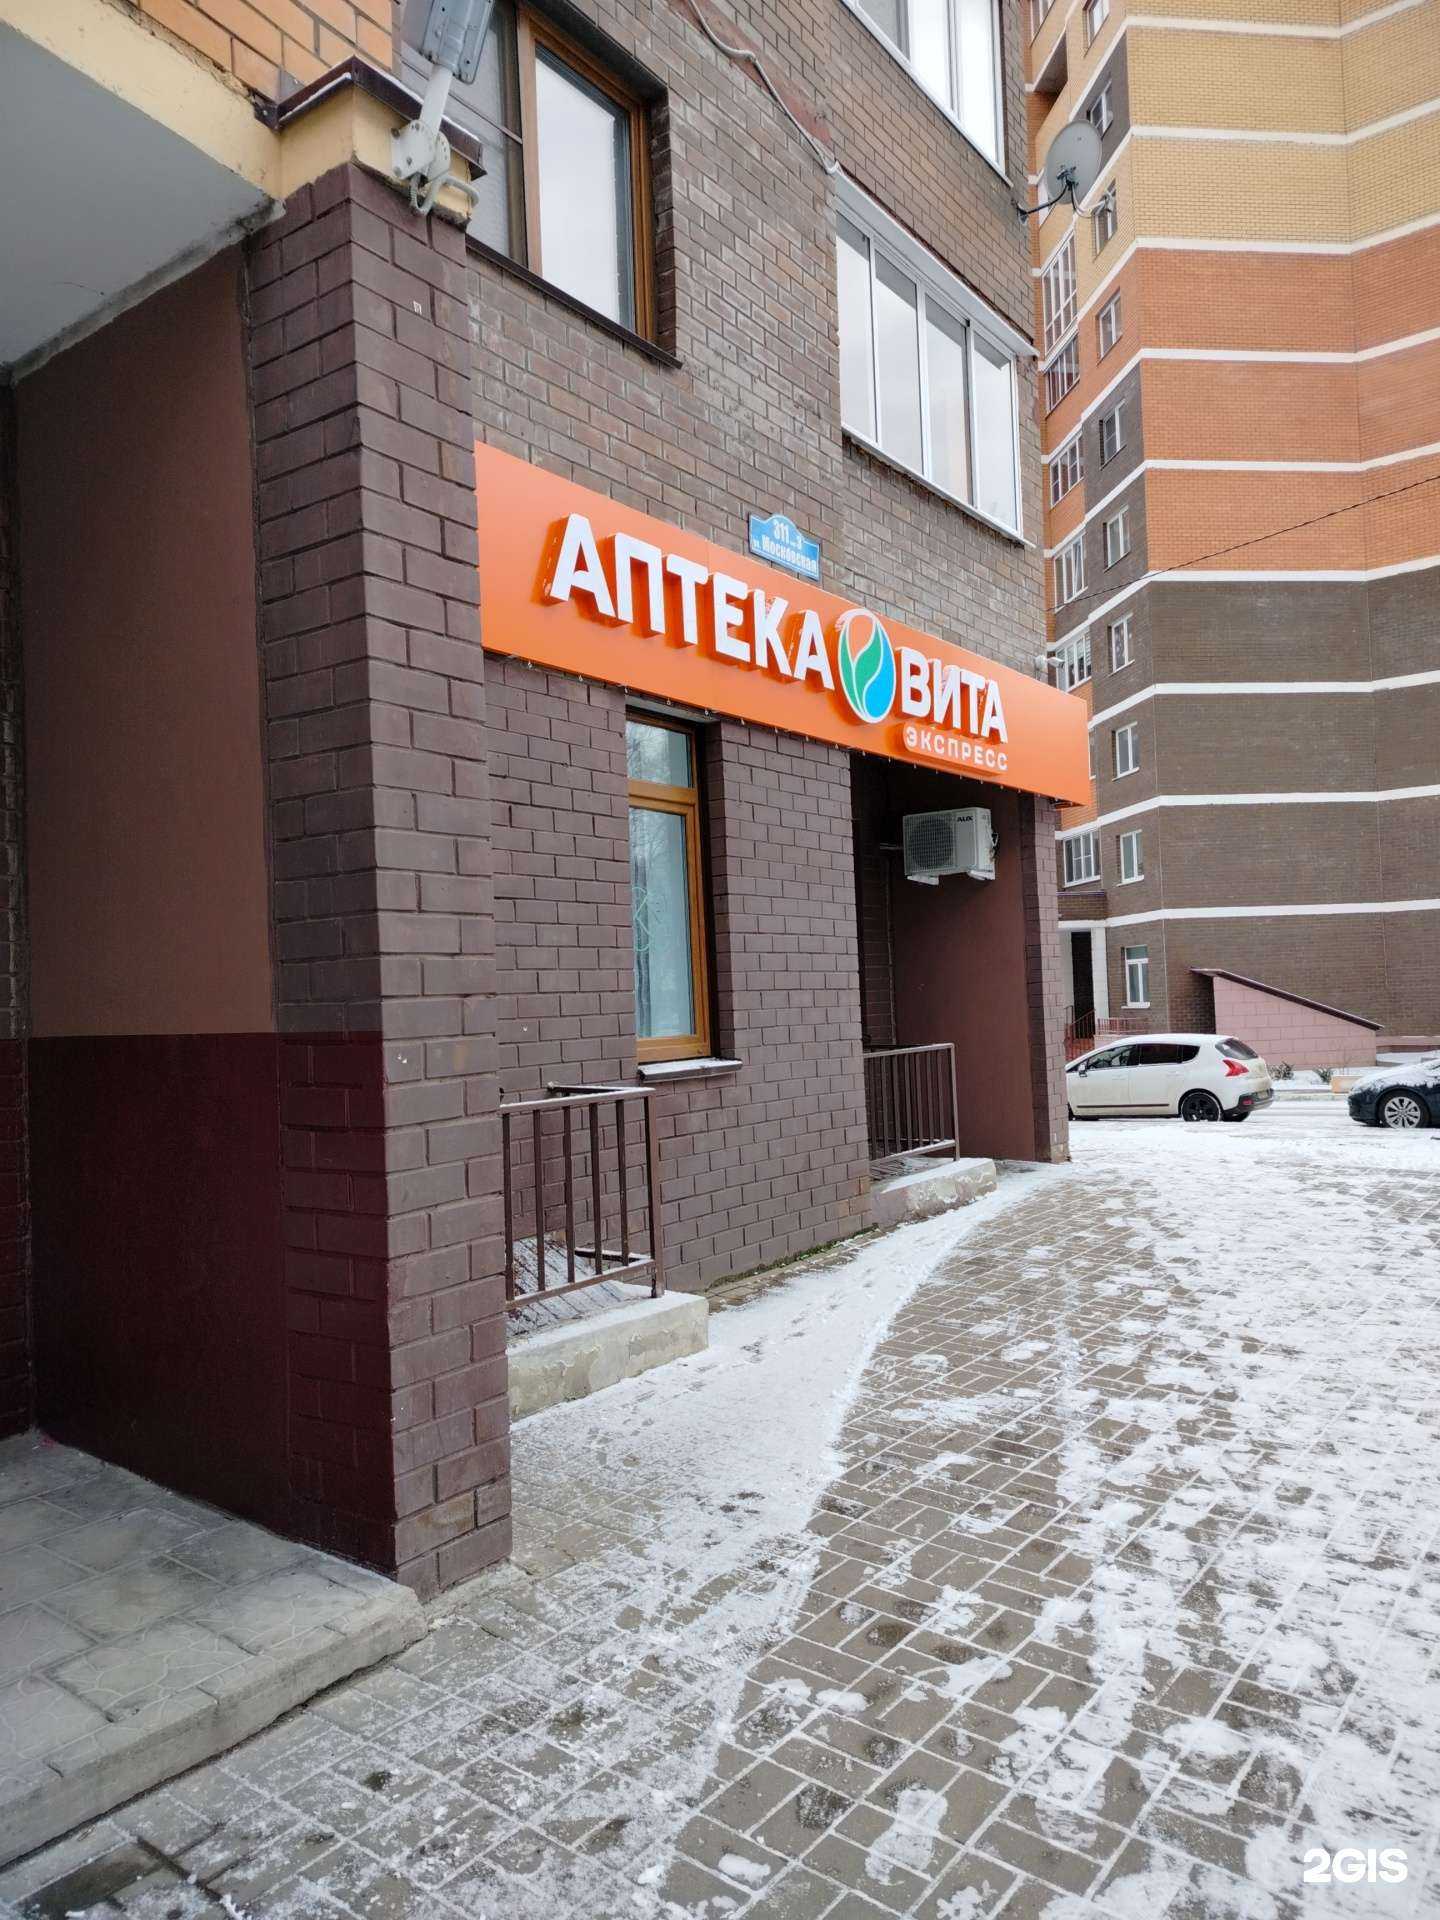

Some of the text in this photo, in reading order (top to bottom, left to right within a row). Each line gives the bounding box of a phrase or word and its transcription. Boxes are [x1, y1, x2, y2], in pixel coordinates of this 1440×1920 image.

[550, 512, 1008, 743] АПТЕКА ВИТА
[906, 726, 1008, 770] ЭКСПРЕСС
